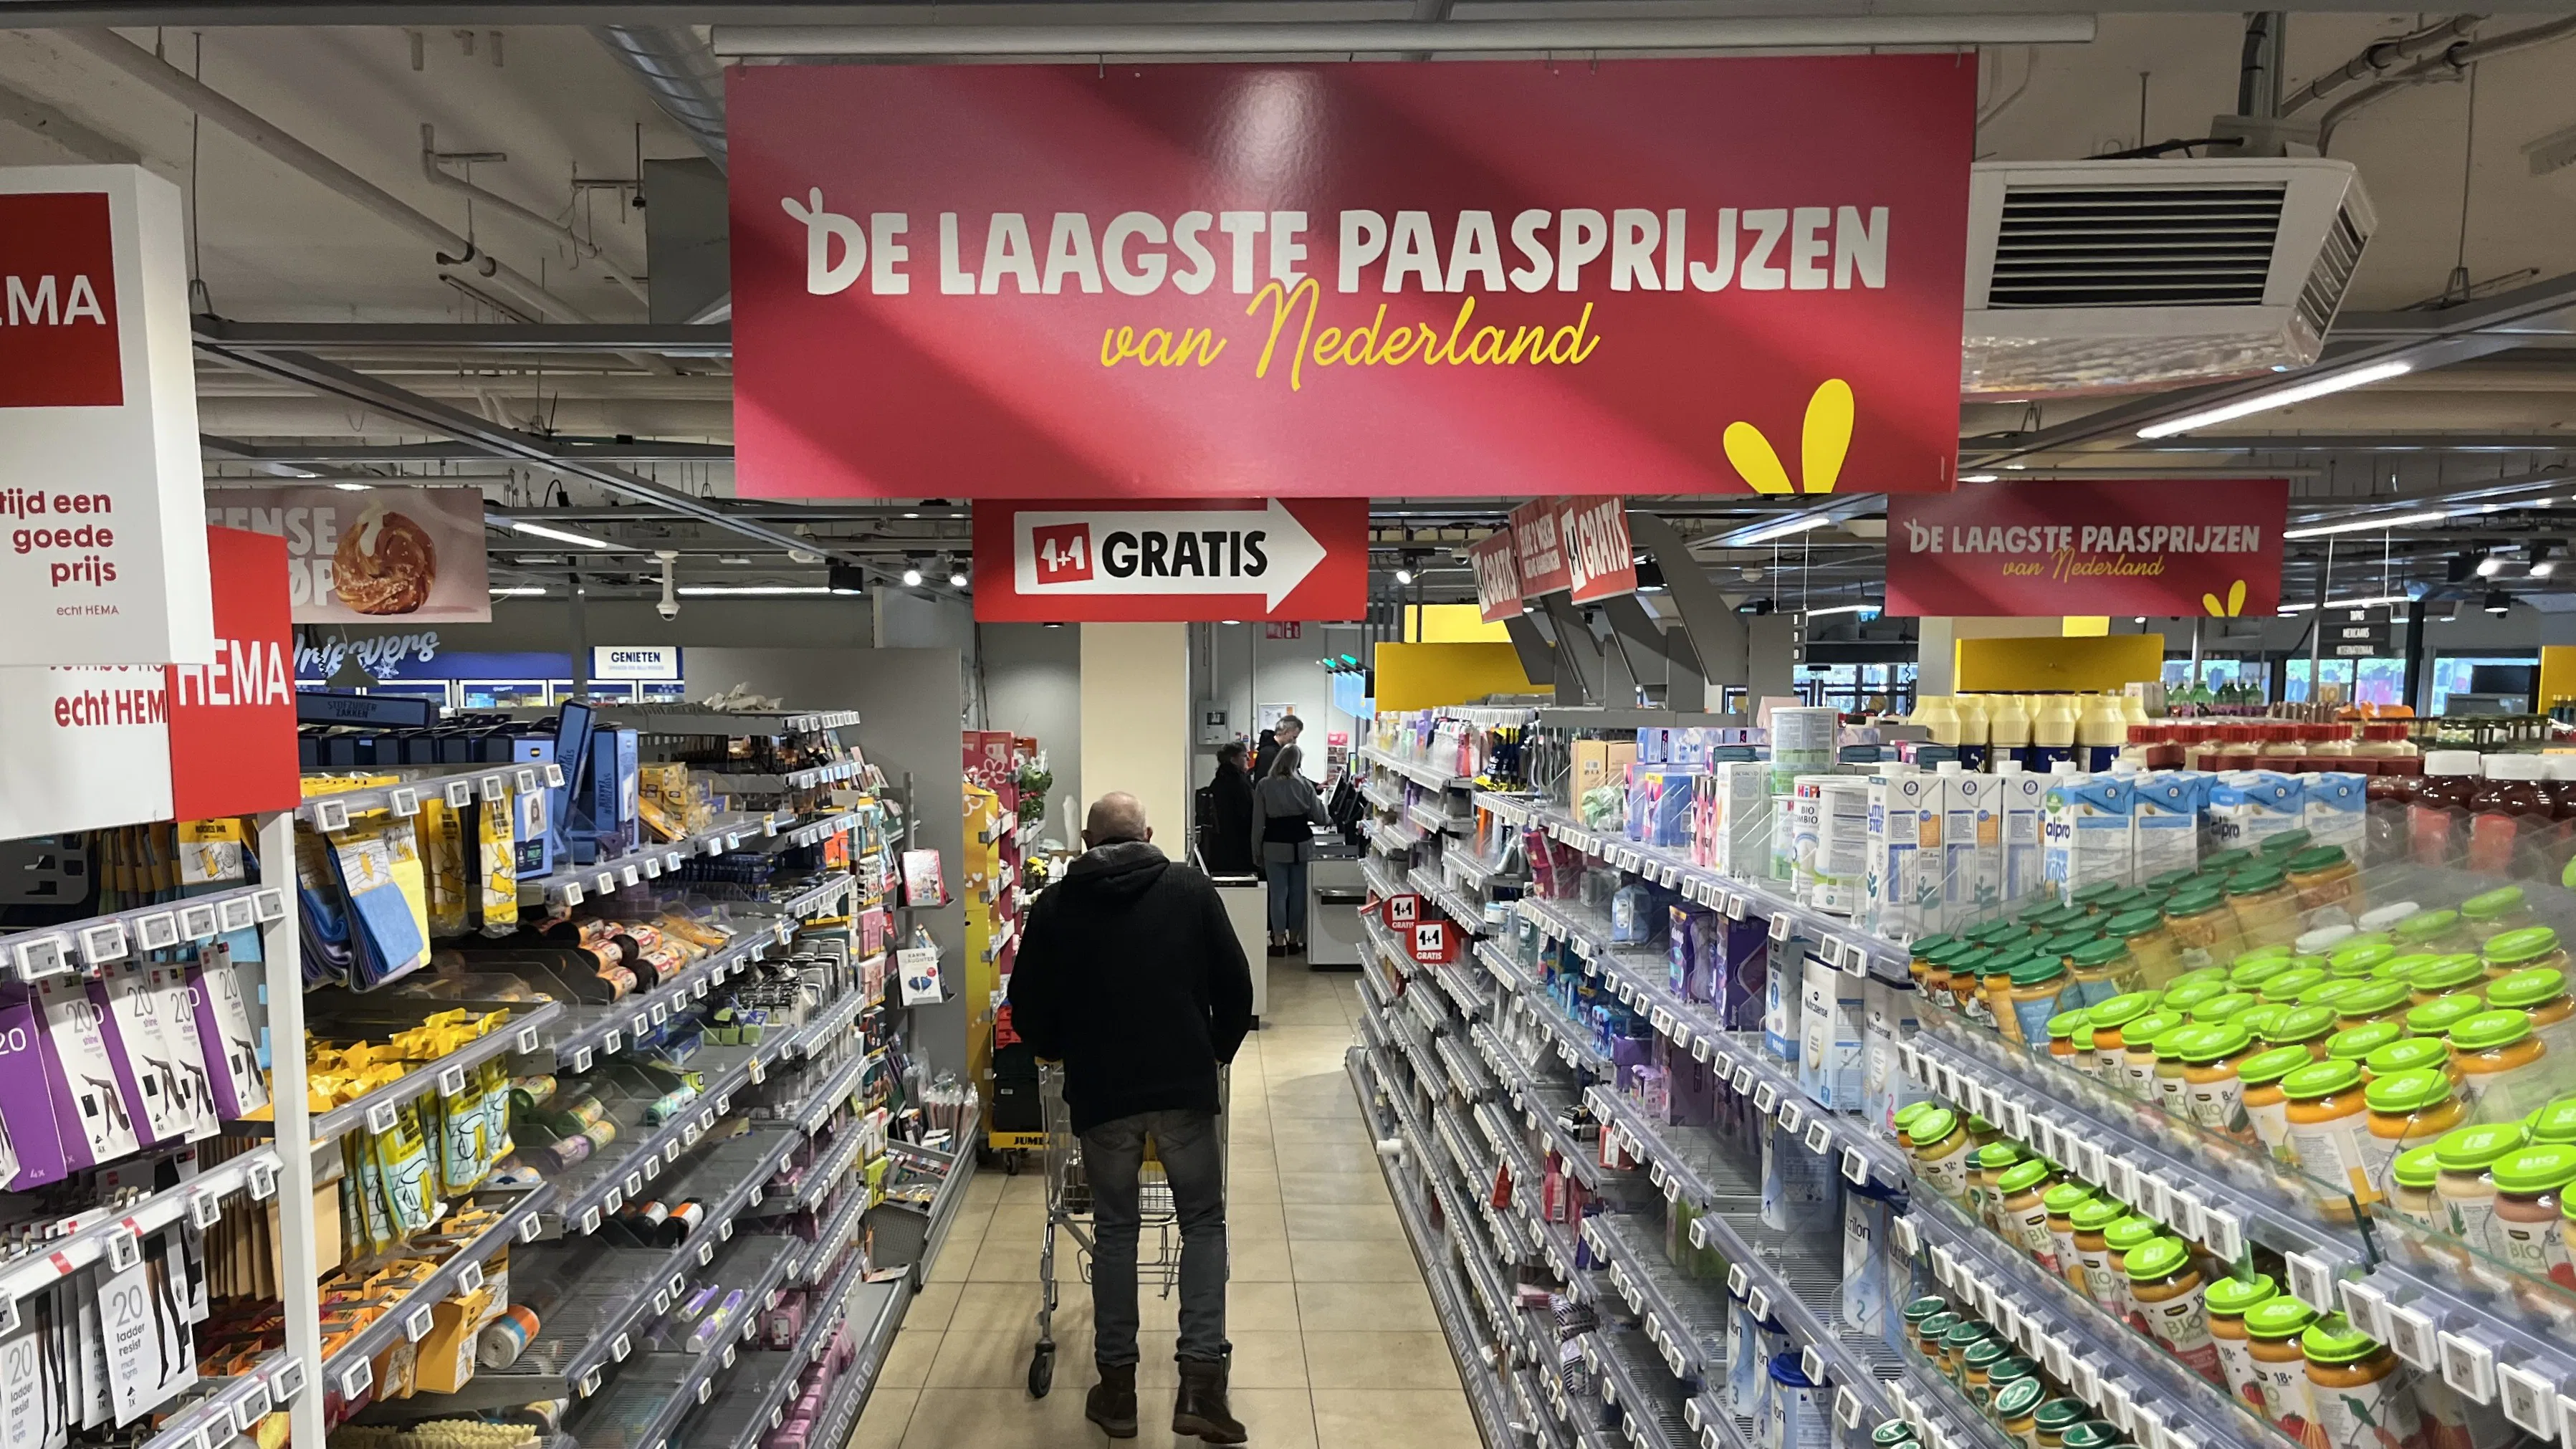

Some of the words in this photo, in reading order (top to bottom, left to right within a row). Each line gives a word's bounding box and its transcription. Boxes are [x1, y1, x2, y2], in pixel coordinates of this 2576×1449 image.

[807, 211, 910, 295] DE
[939, 211, 1308, 296] LAAGSTE
[1338, 206, 1890, 293] PAASPRIJZEN
[1100, 325, 1227, 368] van
[1245, 277, 1601, 392] Nederland
[53, 494, 112, 514] een
[12, 524, 114, 555] goede
[1579, 497, 1629, 580] GRATIS
[1908, 525, 1943, 553] DE
[1952, 525, 2073, 553] LAAGSTE
[2081, 525, 2260, 553] PAASPRIJZEN
[1040, 535, 1086, 573] 1+1
[1101, 530, 1268, 578] GRATIS
[2003, 559, 2044, 576] van
[2051, 547, 2165, 583] Nederland
[50, 555, 118, 588] prijs
[1483, 546, 1518, 606] GRATIS
[56, 606, 82, 616] echt
[85, 604, 120, 615] HEMA
[611, 651, 661, 663] GENIETEN
[177, 639, 291, 706] HEMA
[54, 689, 110, 727] echt
[1801, 806, 1815, 815] BIO
[2046, 816, 2071, 843] alpro
[2211, 815, 2240, 840] alpro
[1393, 901, 1412, 917] 1+1
[1392, 921, 1414, 929] GRATIS
[1419, 929, 1440, 946] 1+1
[1416, 951, 1442, 960] GRATIS
[218, 967, 238, 1000] 20
[127, 984, 153, 1018] 20
[169, 990, 192, 1024] 20
[64, 999, 92, 1034] 20
[111, 1283, 144, 1328] 20
[1857, 1299, 1866, 1322] 2
[115, 1322, 145, 1344] ladder
[118, 1337, 142, 1357] resist
[8, 1339, 33, 1386] 20
[9, 1380, 34, 1402] ladder
[2273, 1372, 2293, 1384] 18+
[1732, 1385, 1739, 1405] 3
[10, 1402, 30, 1419] resist
